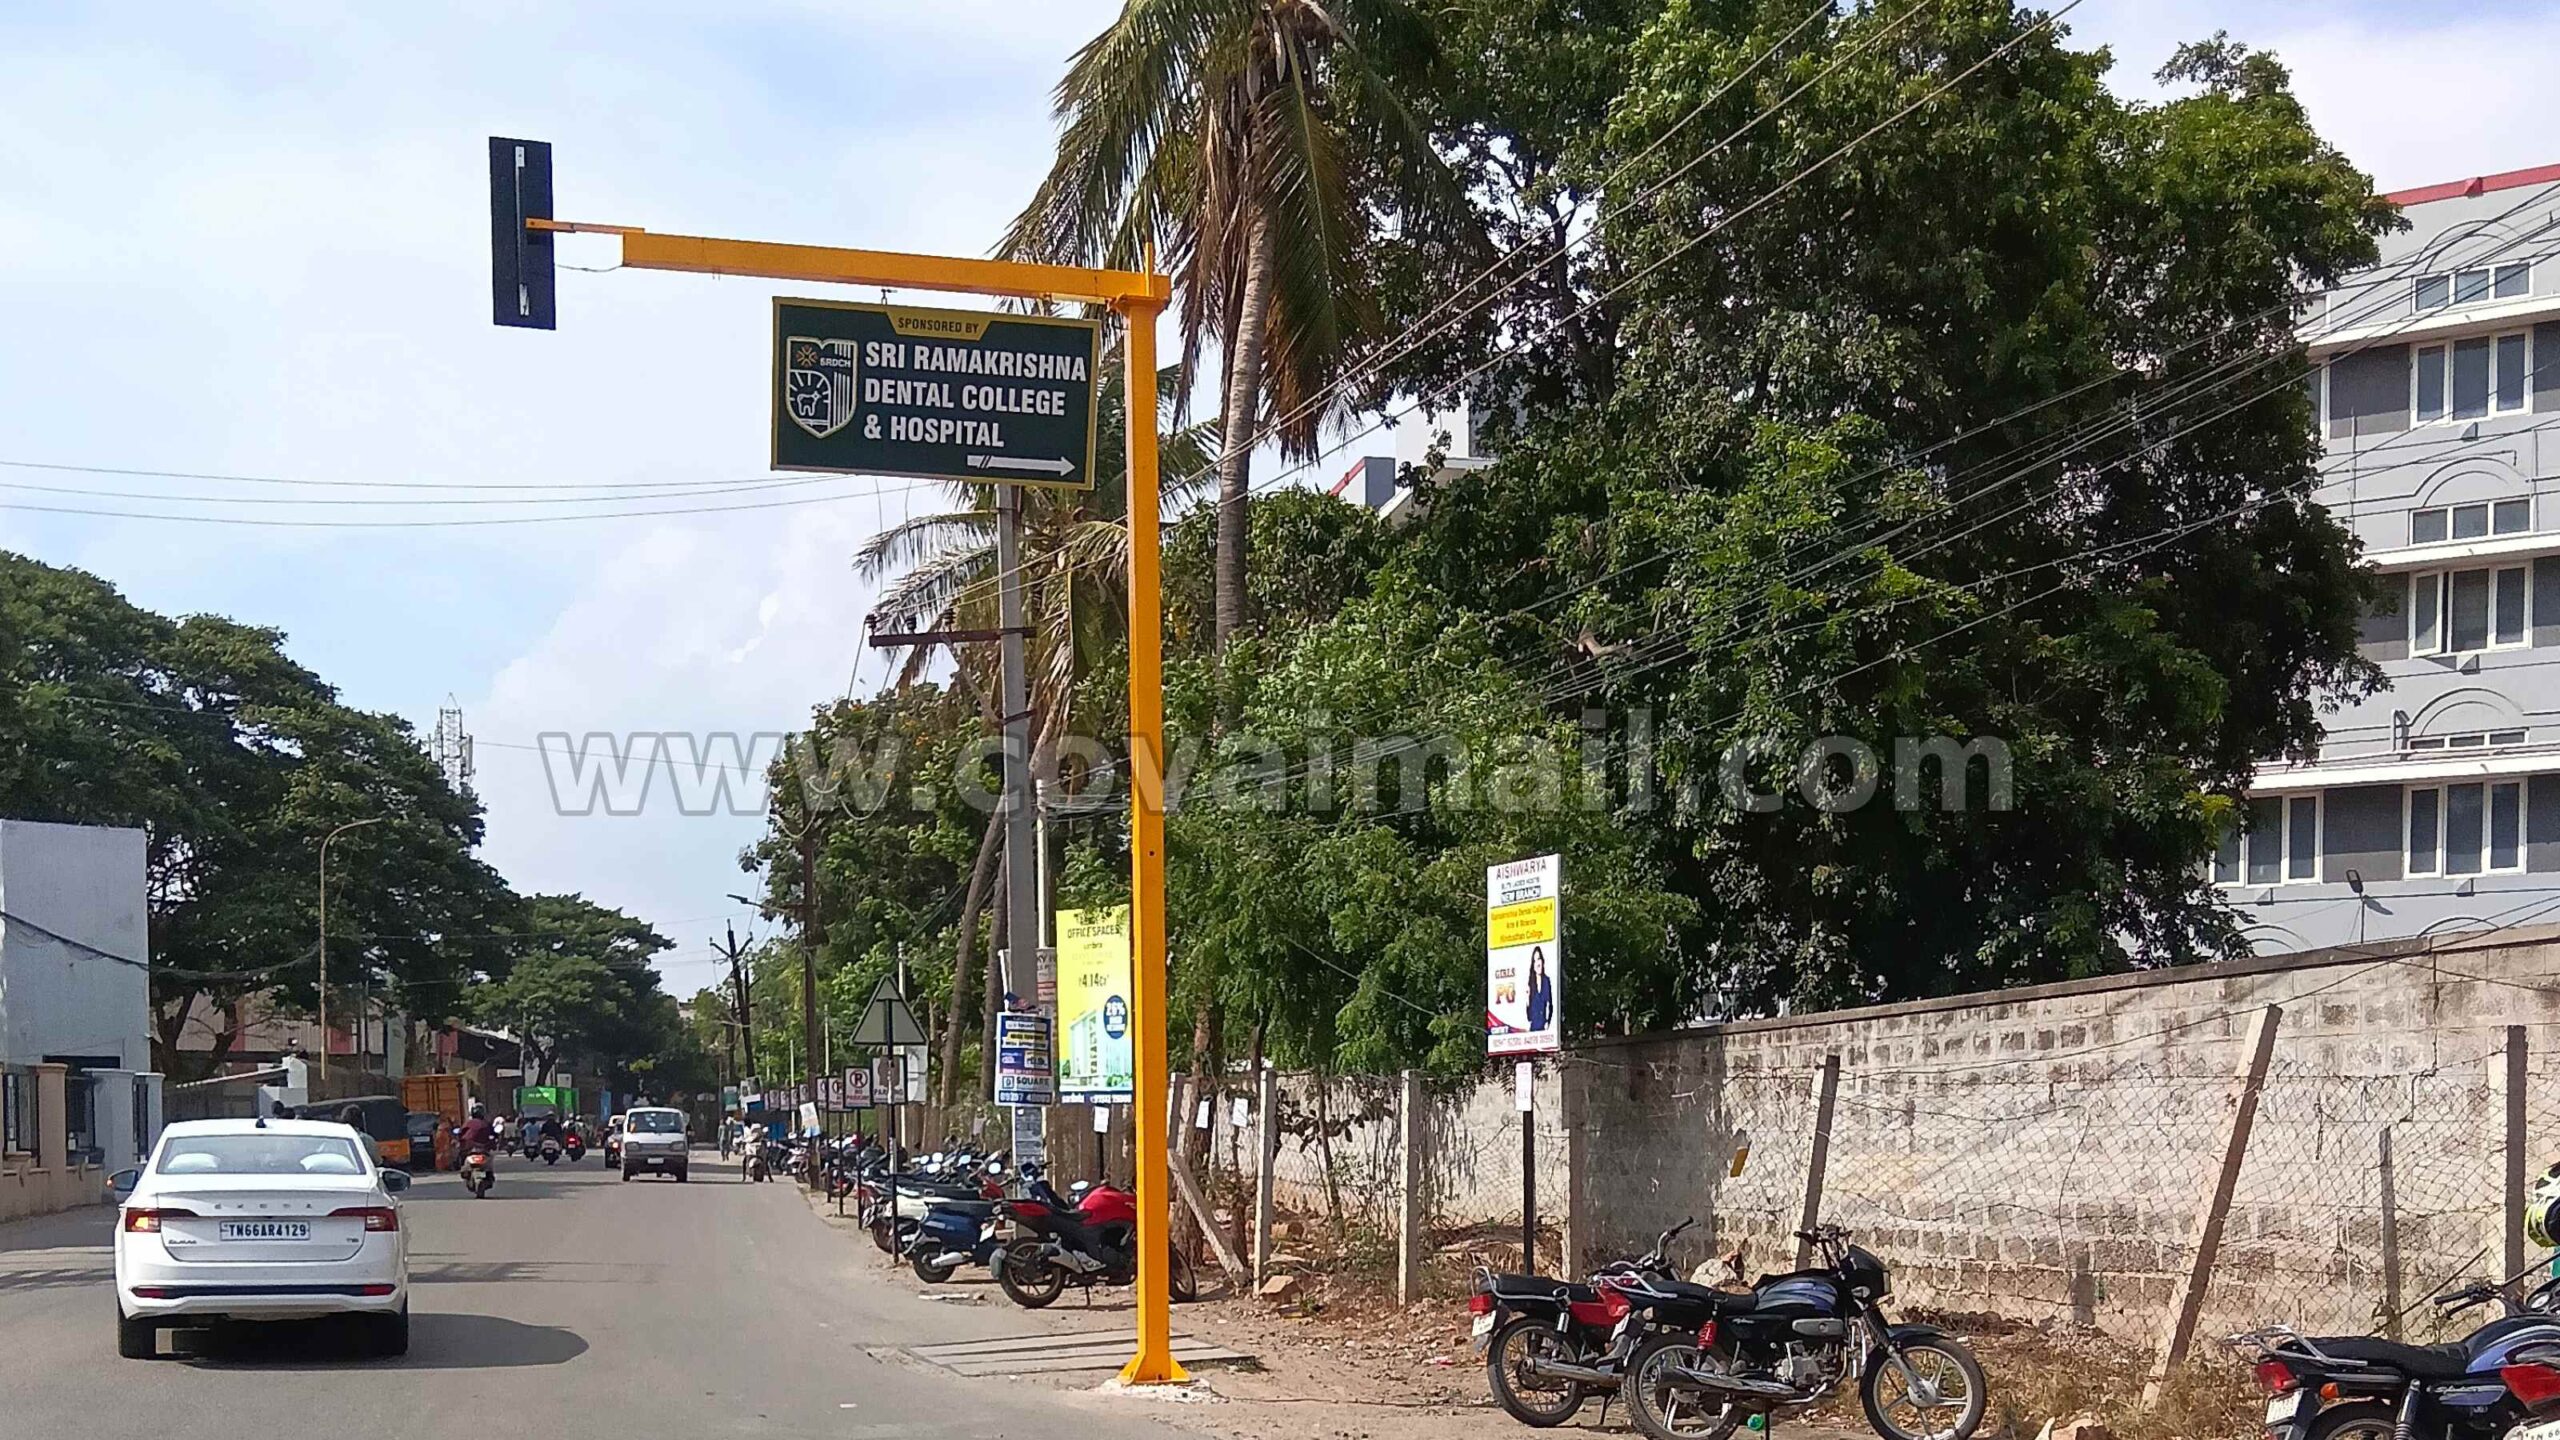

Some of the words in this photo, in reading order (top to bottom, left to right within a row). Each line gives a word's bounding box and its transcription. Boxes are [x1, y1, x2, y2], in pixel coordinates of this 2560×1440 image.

[897, 316, 962, 333] SPONSORED
[965, 321, 979, 334] BY
[865, 341, 905, 369] SRI
[914, 345, 1087, 382] RAMAKRISHNA
[864, 378, 955, 409] DENTAL
[962, 384, 1066, 416] COLLEGE
[863, 414, 882, 440] &
[890, 415, 1004, 448] HOSPITAL
[1496, 859, 1547, 880] AISHWARYA
[228, 1223, 307, 1237] TN66AR4129
